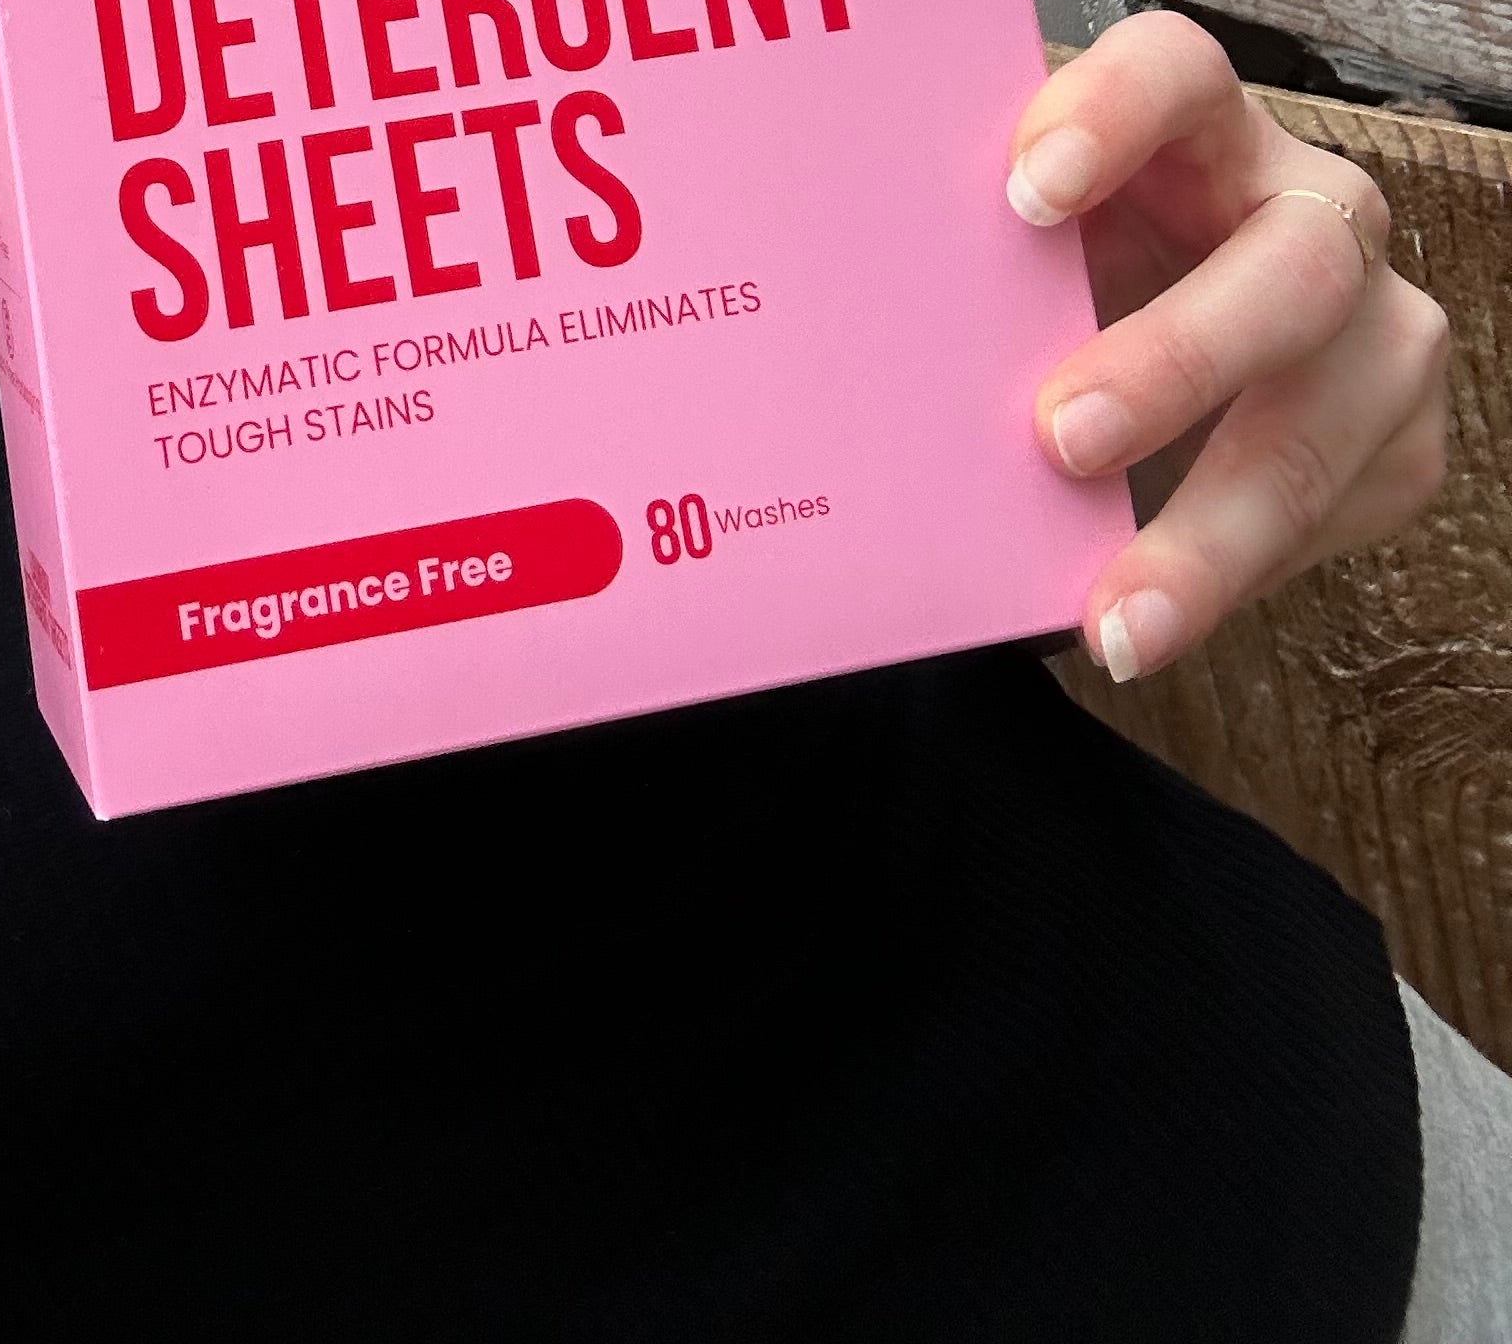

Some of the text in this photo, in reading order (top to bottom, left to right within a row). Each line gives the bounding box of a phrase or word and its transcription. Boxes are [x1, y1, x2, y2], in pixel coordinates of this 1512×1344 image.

[118, 89, 643, 343] SHEETS
[147, 280, 762, 418] ENZYMATIC FORMULA ELIMINATES
[153, 389, 436, 470] TOUGH STAINS
[644, 492, 832, 567] 80 Washes
[177, 546, 514, 640] Fragrance Free
